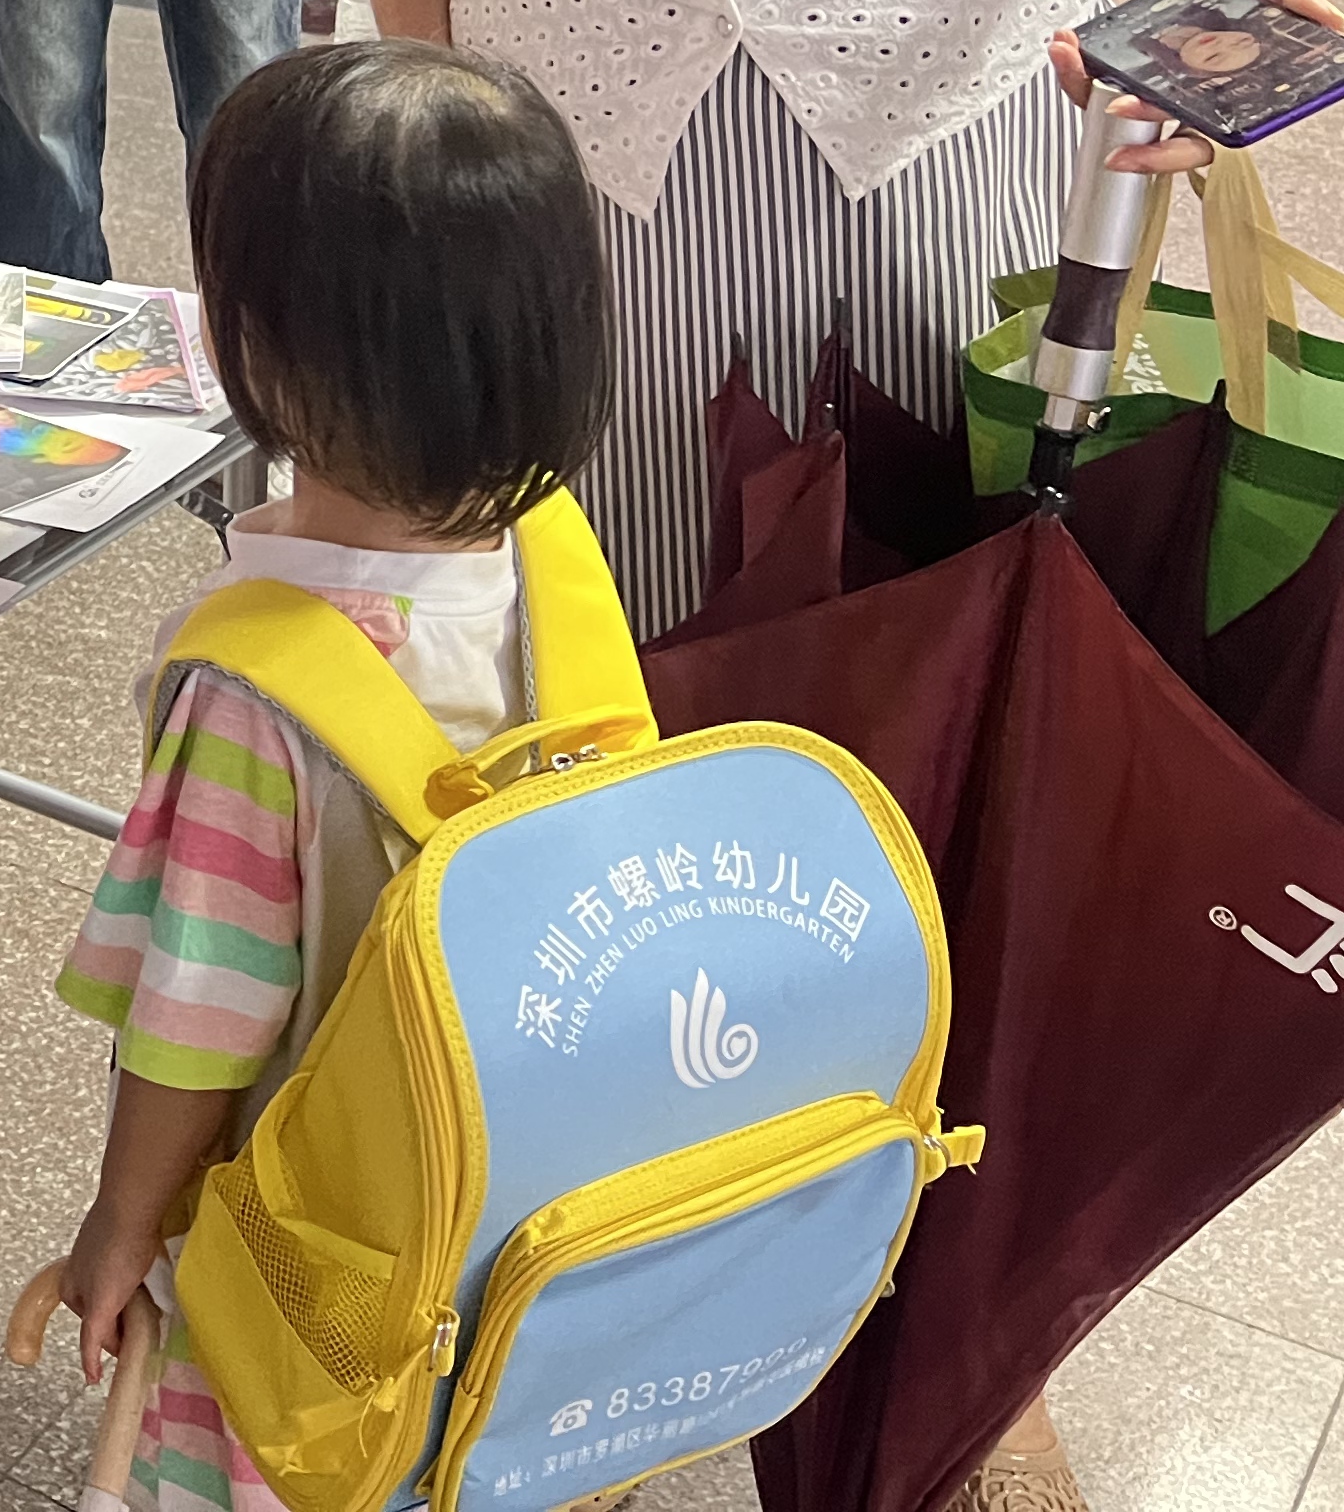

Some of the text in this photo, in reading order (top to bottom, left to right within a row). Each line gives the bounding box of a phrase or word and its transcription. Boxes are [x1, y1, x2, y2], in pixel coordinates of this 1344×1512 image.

[515, 839, 871, 1049] 深圳市螺岭幼儿园
[563, 896, 856, 1058] SHEN ZHEN LUO LING KINDERGARTEN
